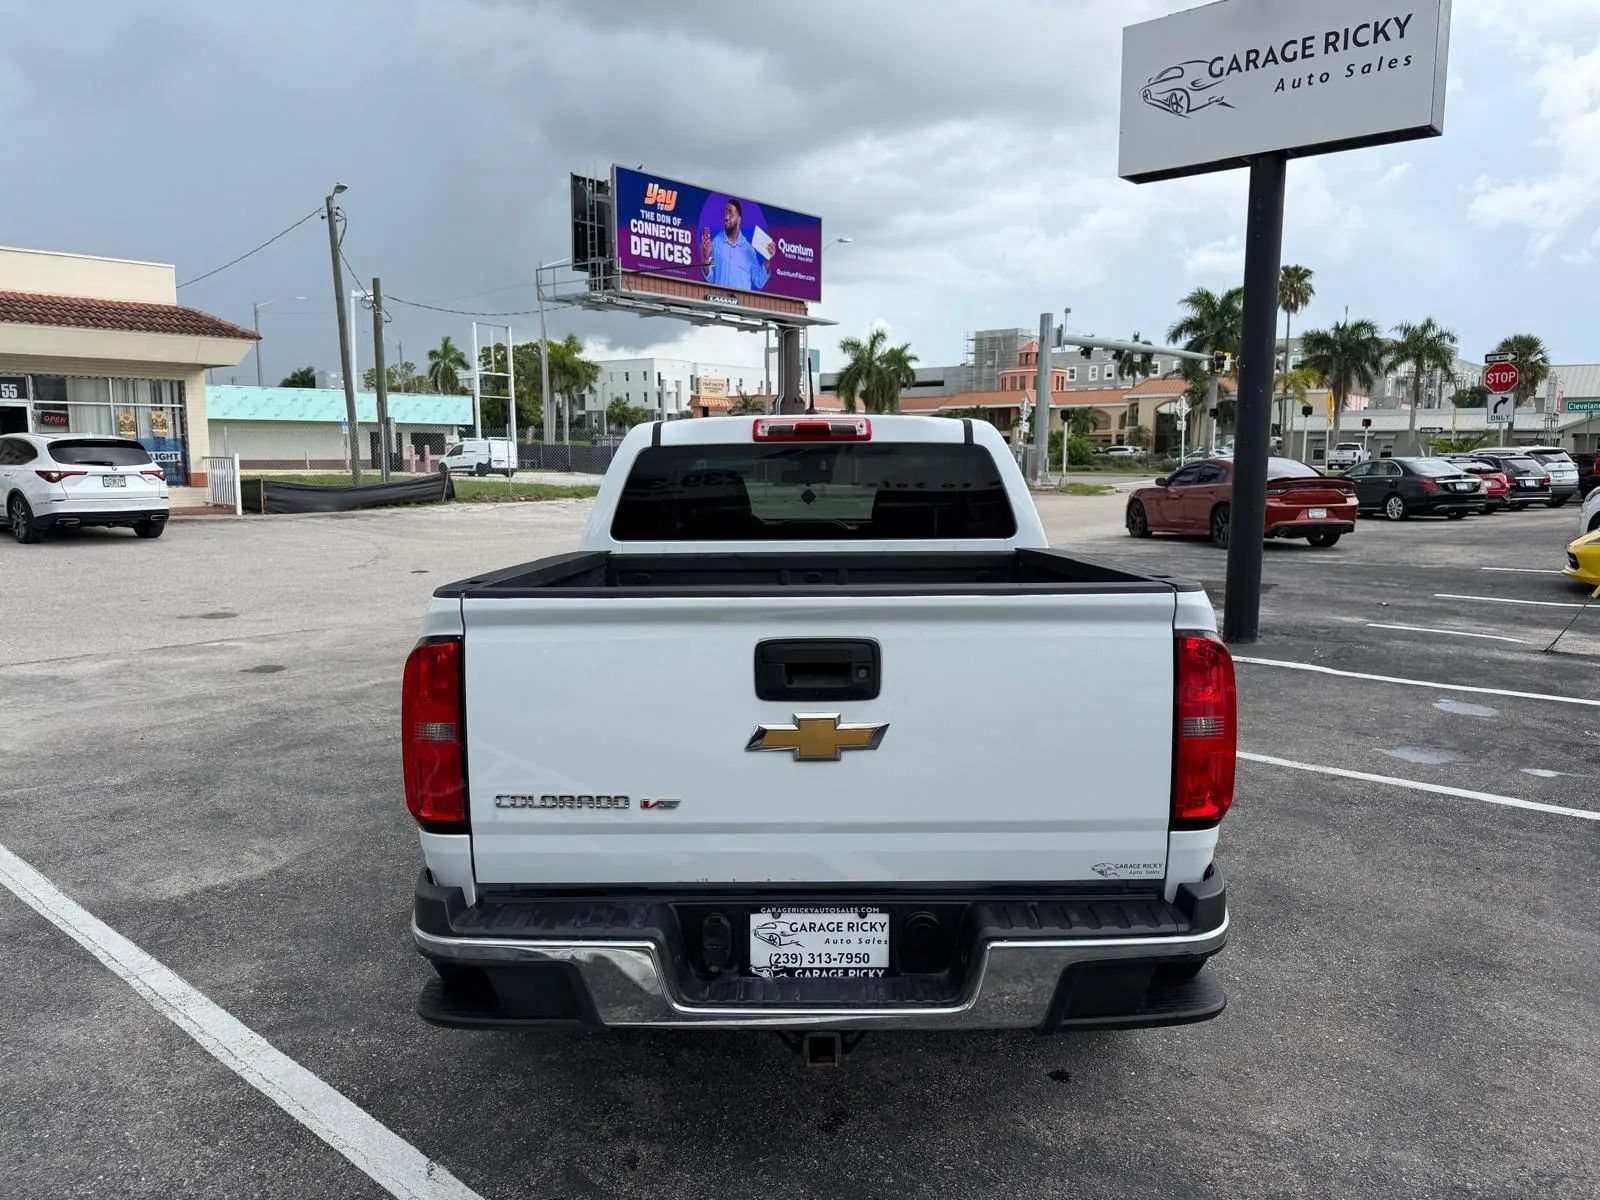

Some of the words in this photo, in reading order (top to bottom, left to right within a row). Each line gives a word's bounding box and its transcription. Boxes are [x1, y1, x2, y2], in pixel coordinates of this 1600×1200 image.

[1208, 36, 1315, 79] GARAGE
[1323, 13, 1414, 55] RICKY
[1274, 71, 1331, 93] Auto
[1345, 54, 1413, 78] Sales
[640, 209, 655, 221] THE
[656, 213, 671, 225] DON
[672, 217, 682, 227] OF
[630, 218, 692, 244] CONNECTED
[630, 234, 692, 265] DEVICES
[778, 237, 814, 257] Quantum
[1486, 371, 1516, 385] STOP
[0, 383, 18, 399] 55
[1568, 402, 1600, 410] Clevelan
[43, 415, 67, 424] OPEN
[495, 795, 630, 809] COLORADO
[789, 922, 843, 933] GARAGE
[847, 922, 887, 933] RICKY
[858, 937, 888, 945] Sales
[769, 952, 803, 967] (239)
[807, 953, 870, 964] 313-7950
